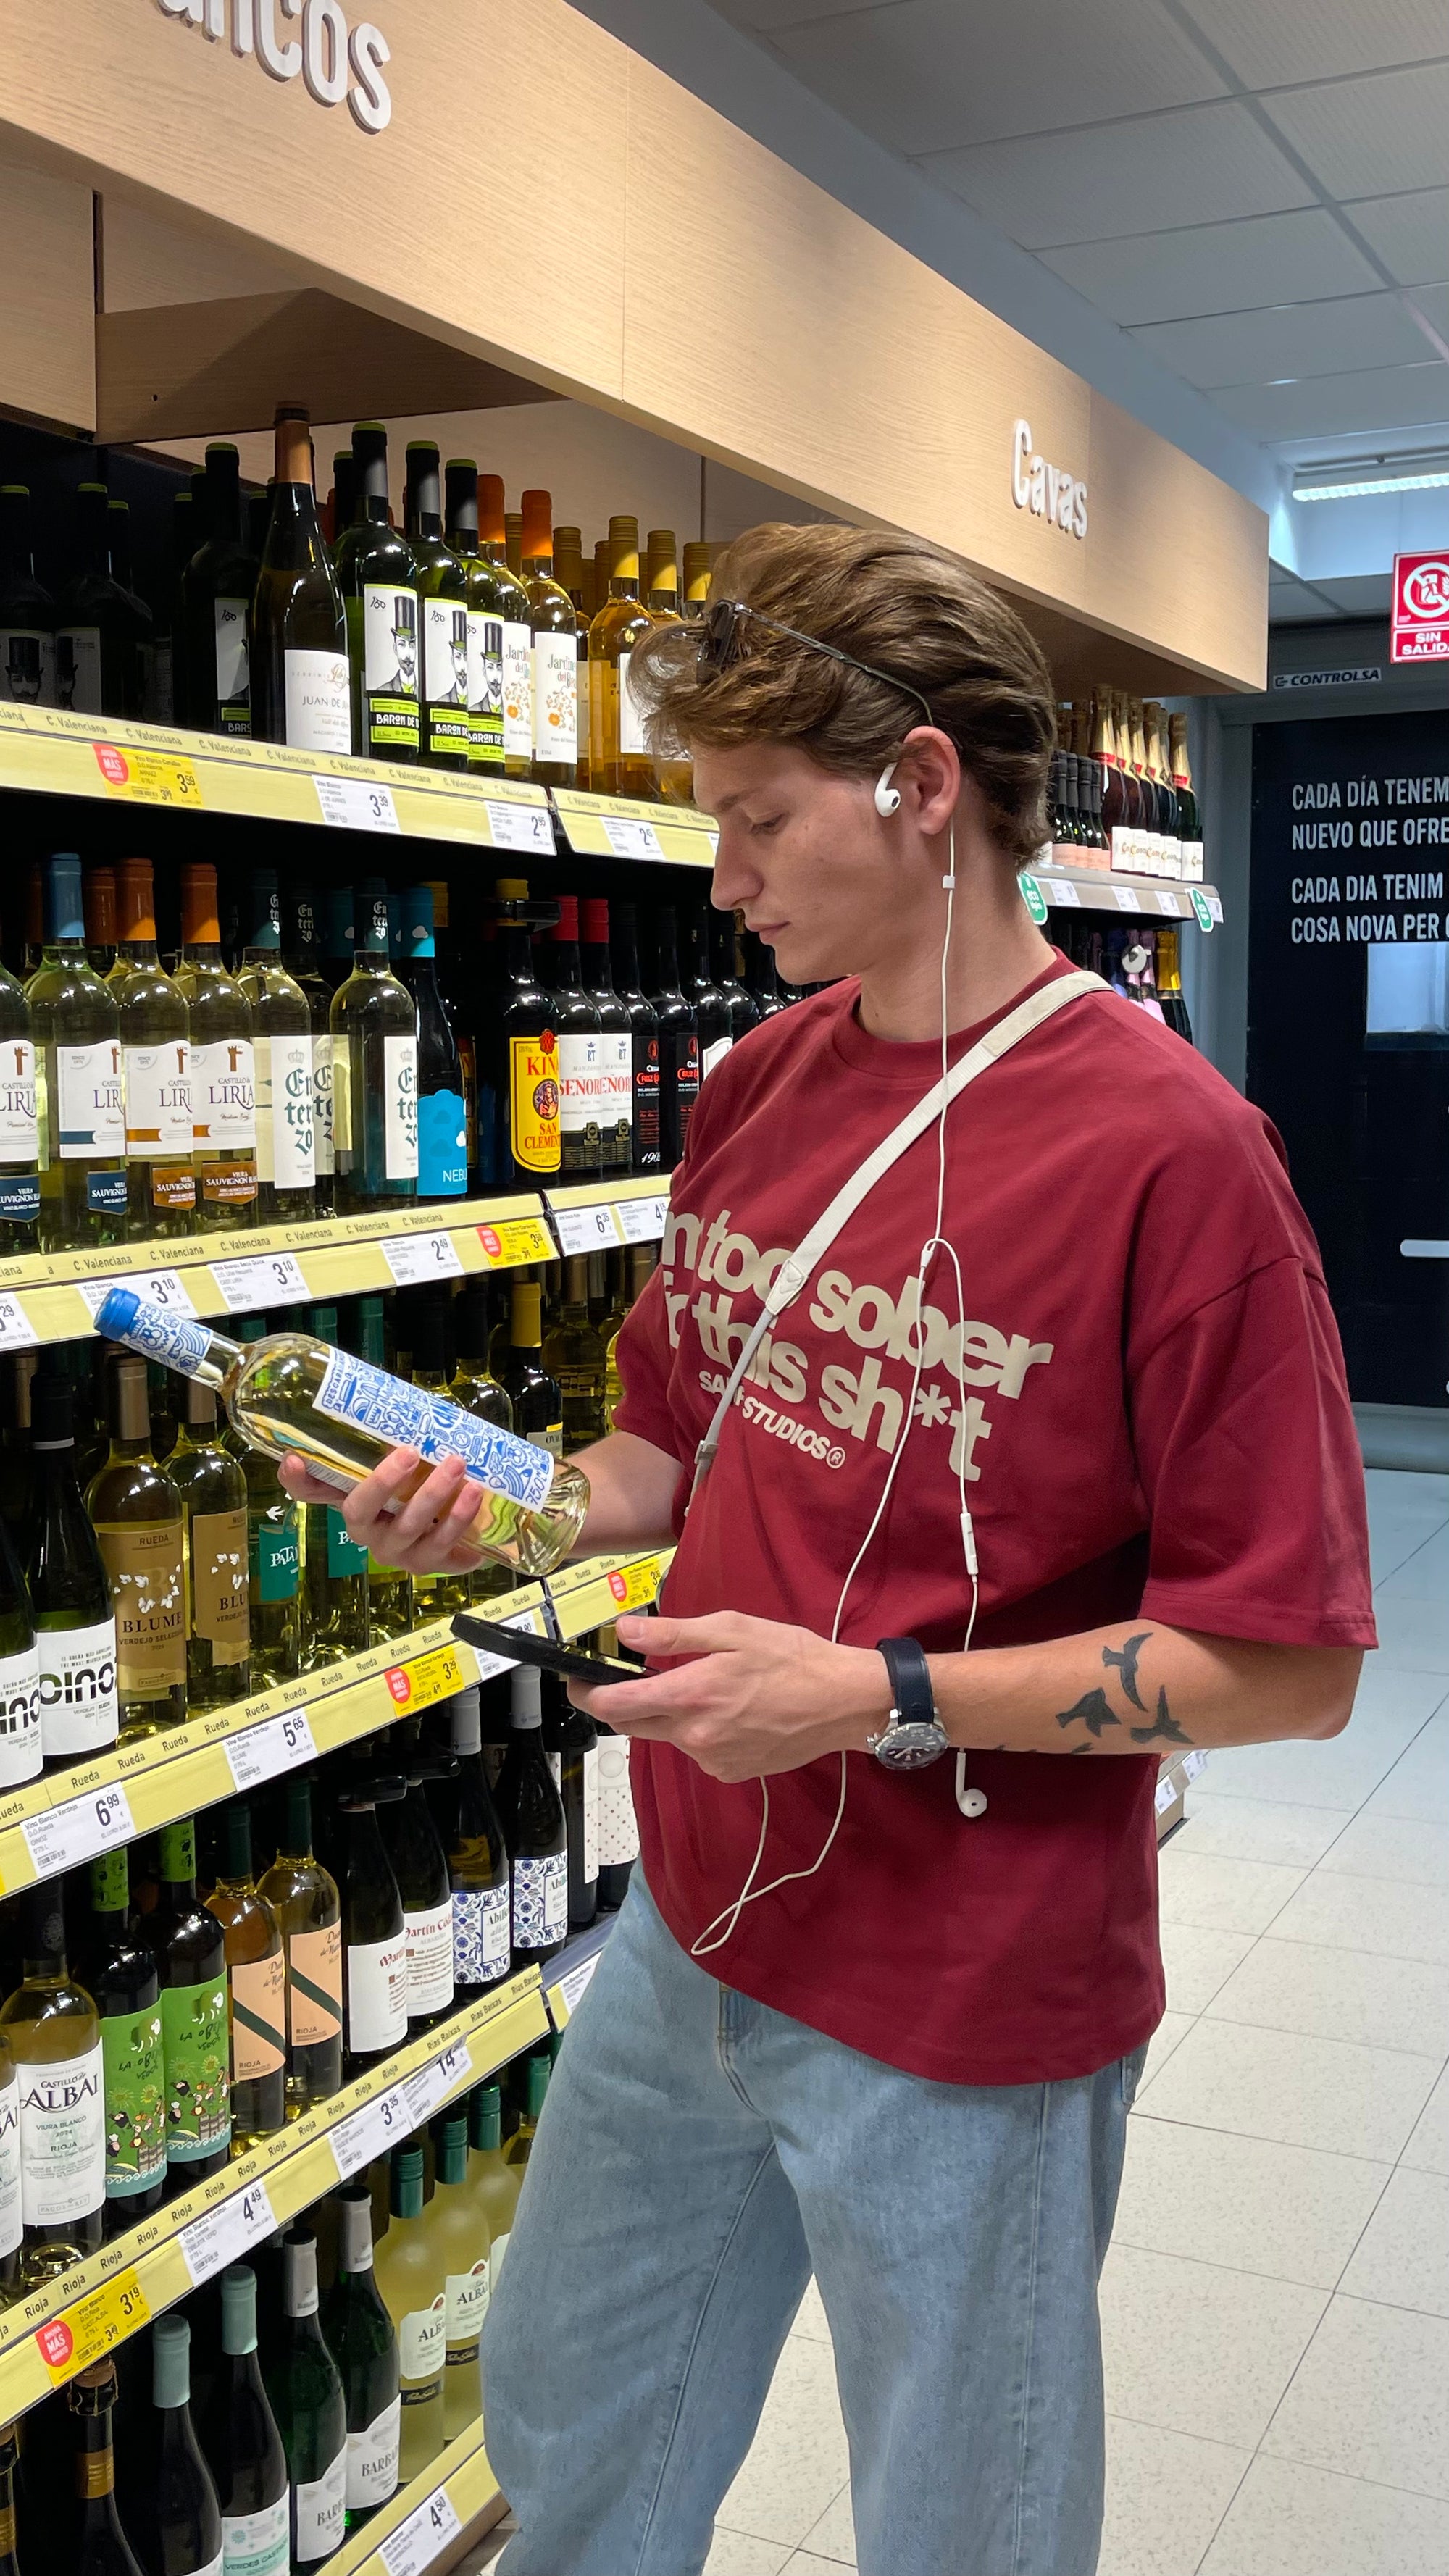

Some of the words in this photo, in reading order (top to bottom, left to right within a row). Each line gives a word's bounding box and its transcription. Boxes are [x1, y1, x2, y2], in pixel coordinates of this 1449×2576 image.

[1013, 419, 1087, 539] Cavas
[1415, 631, 1441, 644] SIN
[1291, 670, 1379, 686] CONTROLSA
[302, 696, 328, 707] JUAN
[331, 698, 341, 708] DE
[209, 740, 251, 757] Valenciana
[1292, 782, 1341, 811] CADA
[1347, 774, 1379, 807] DÍA
[1293, 821, 1353, 850] NUEVO
[1359, 819, 1398, 848] QUE
[1292, 877, 1340, 904] CADA
[1346, 874, 1377, 902] DIA
[1382, 871, 1443, 900] TENIM
[1291, 916, 1340, 944] COSA
[1346, 913, 1398, 942] NOVA
[1403, 913, 1440, 940] PER
[540, 1123, 556, 1135] SAN
[206, 1177, 246, 1186] SAUVIGNON
[293, 1228, 333, 1241] Valenciana
[354, 1220, 389, 1232] Valenciana
[161, 1245, 204, 1259] Valenciana
[229, 1237, 271, 1250] Valenciana
[84, 1255, 133, 1270] Valenciana
[809, 1269, 1054, 1400] sober
[139, 1534, 169, 1546] RUEDA
[600, 1558, 615, 1571] Rueda
[575, 1568, 591, 1581] Rueda
[551, 1579, 567, 1592] Rueda
[512, 1594, 530, 1607] Rueda
[483, 1606, 502, 1618] Rueda
[122, 1611, 182, 1634] BLUME
[119, 1636, 154, 1645] VERDEJO
[422, 1629, 442, 1645] Rueda
[390, 1643, 411, 1658] Rueda
[356, 1657, 377, 1673] Rueda
[322, 1670, 343, 1687] Rueda
[283, 1686, 308, 1703] Rueda
[245, 1701, 270, 1718] Rueda
[205, 1718, 230, 1735] Rueda
[162, 1734, 188, 1752] Rueda
[117, 1752, 146, 1770] Rueda
[71, 1770, 101, 1789] Rueda
[382, 2064, 399, 2080] Rioja
[41, 2075, 78, 2089] CASTILLO
[354, 2082, 372, 2099] Rioja
[327, 2101, 346, 2118] Rioja
[60, 2115, 87, 2128] BLANCO
[298, 2119, 317, 2137] Rioja
[51, 2141, 78, 2152] RIOJA
[268, 2138, 288, 2157] Rioja
[238, 2159, 257, 2178] Rioja
[204, 2181, 225, 2200] Rioja
[171, 2203, 193, 2223] Rioja
[136, 2225, 159, 2246] Rioja
[100, 2249, 123, 2270] Rioja
[62, 2273, 86, 2296] Rioja
[25, 2297, 49, 2320] Rioja
[225, 2560, 259, 2571] VERDES
